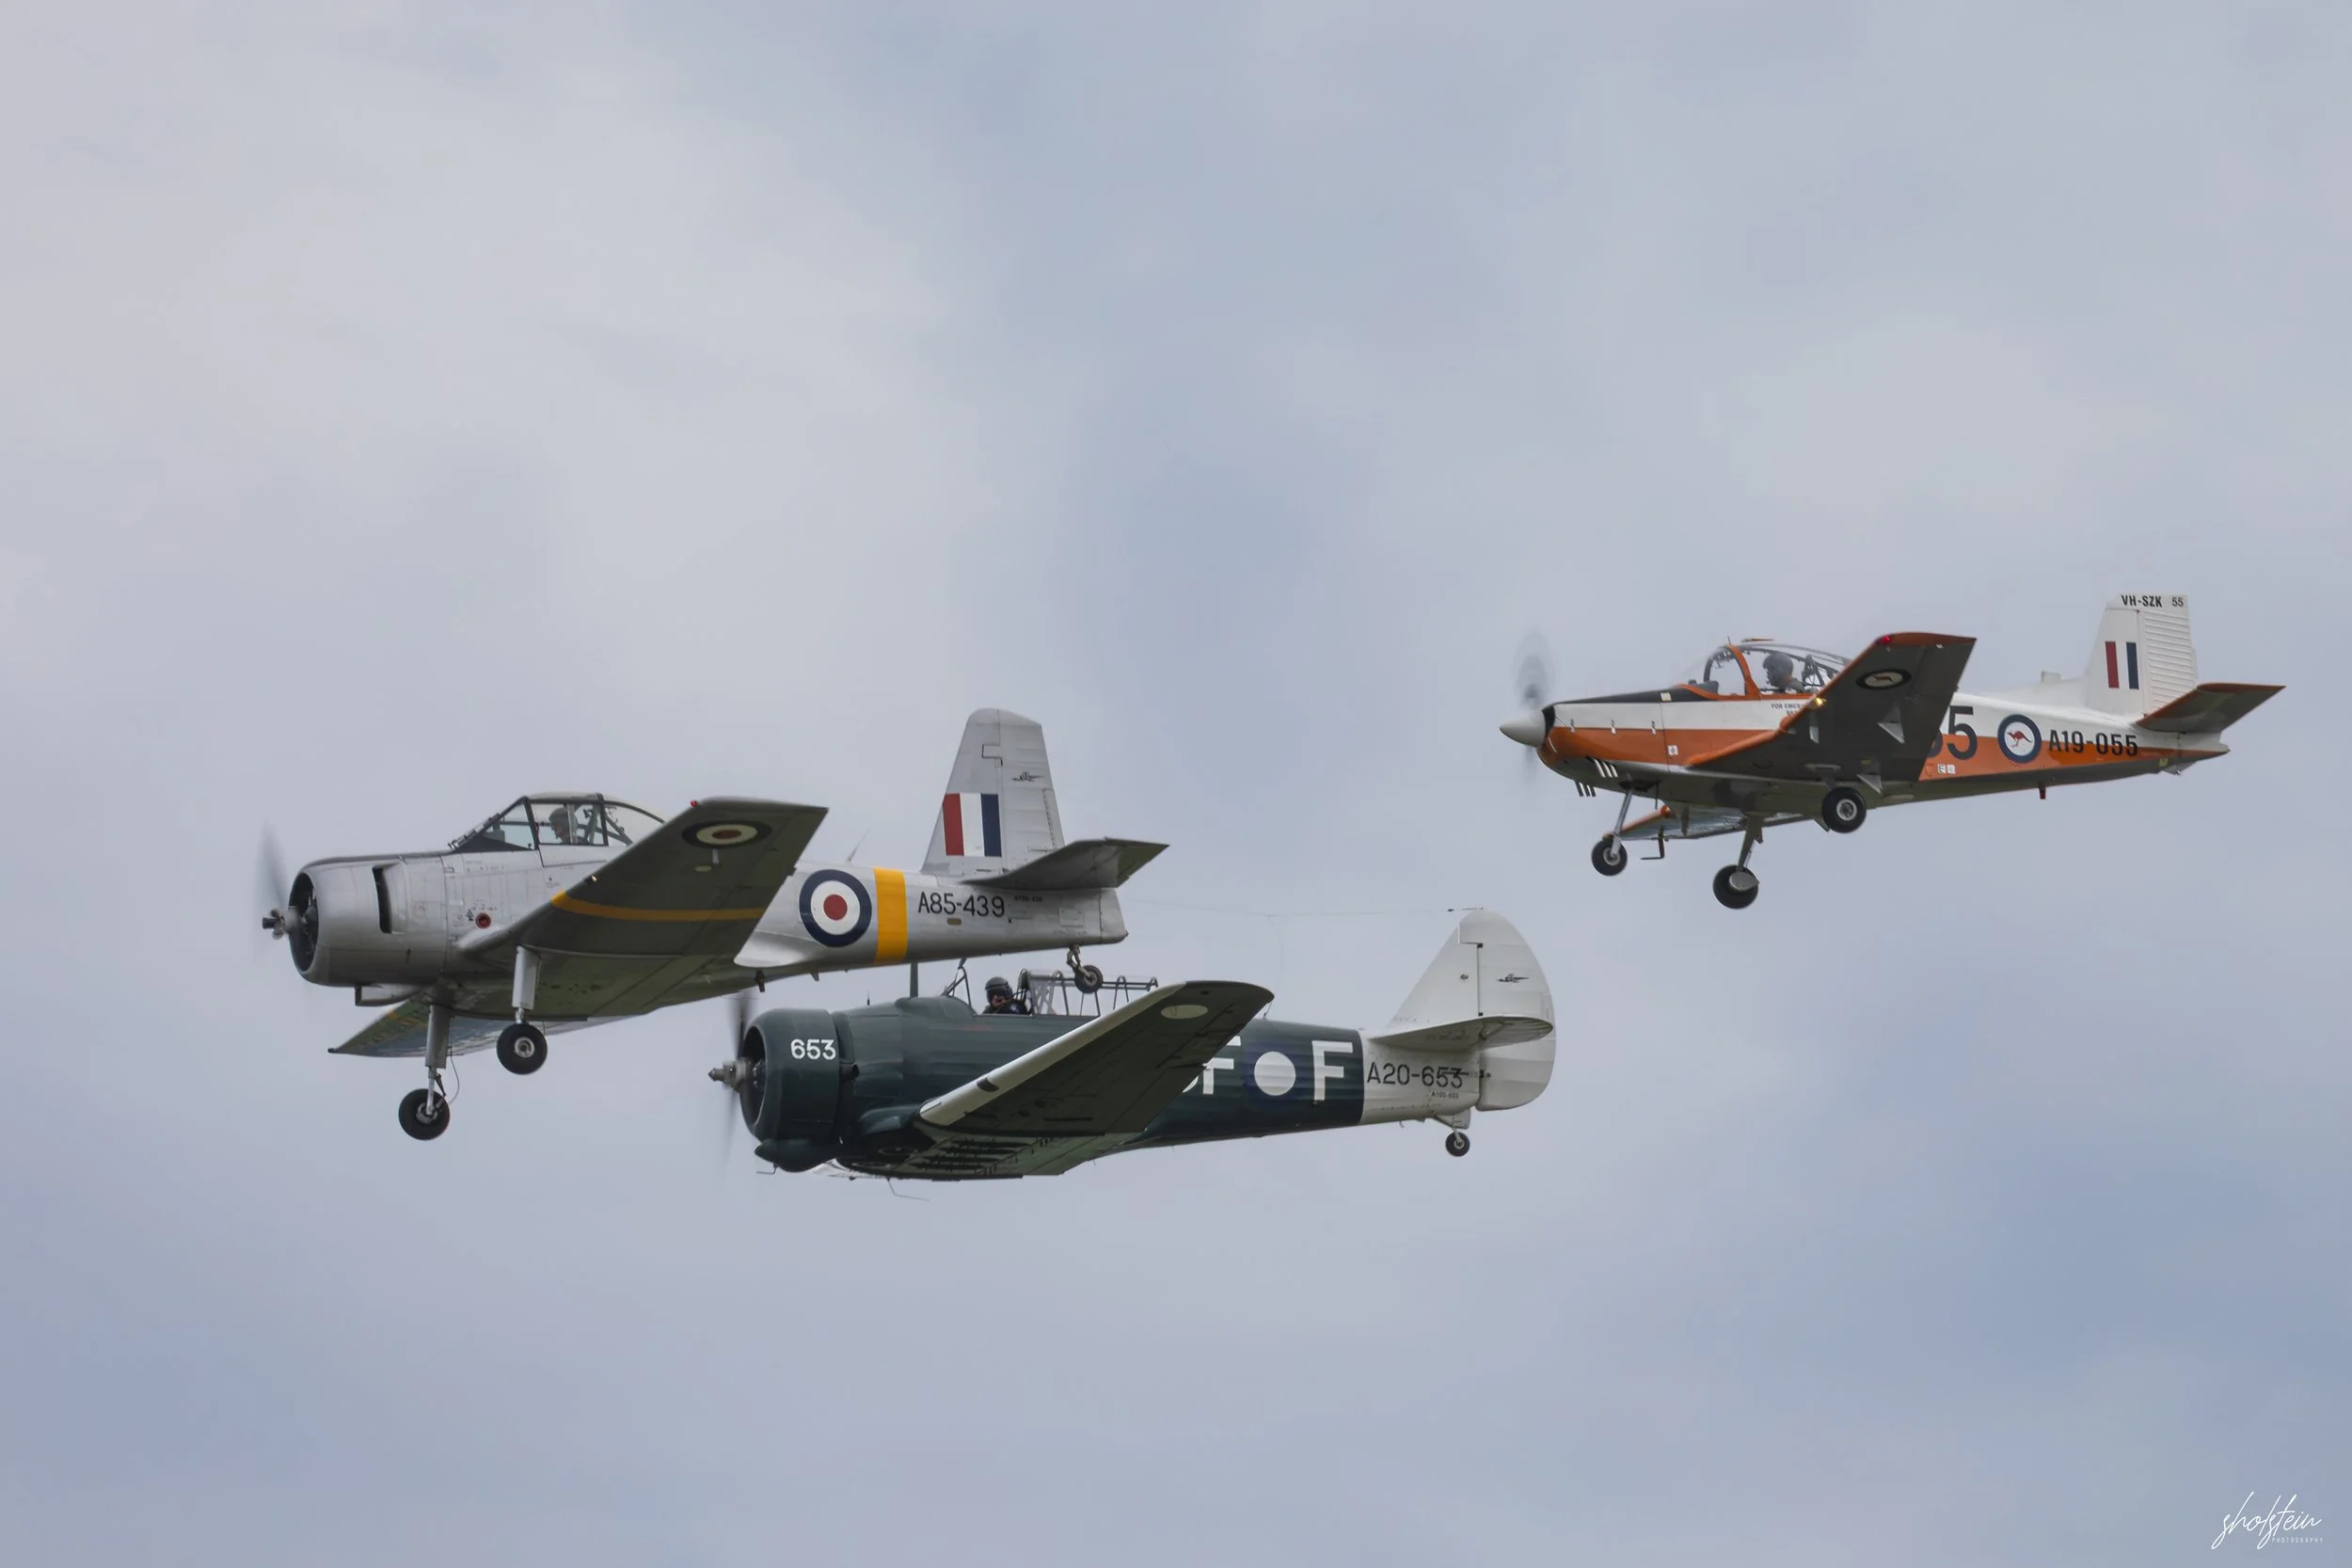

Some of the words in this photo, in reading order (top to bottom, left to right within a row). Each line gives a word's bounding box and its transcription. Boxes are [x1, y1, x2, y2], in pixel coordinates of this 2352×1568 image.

[2121, 594, 2163, 608] VH-SZK
[2171, 596, 2184, 608] 55
[2049, 729, 2138, 757] A19-055
[918, 891, 1005, 918] A85-439
[790, 1038, 836, 1060] 653
[1311, 1039, 1353, 1101] F
[1367, 1061, 1463, 1088] A20-653
